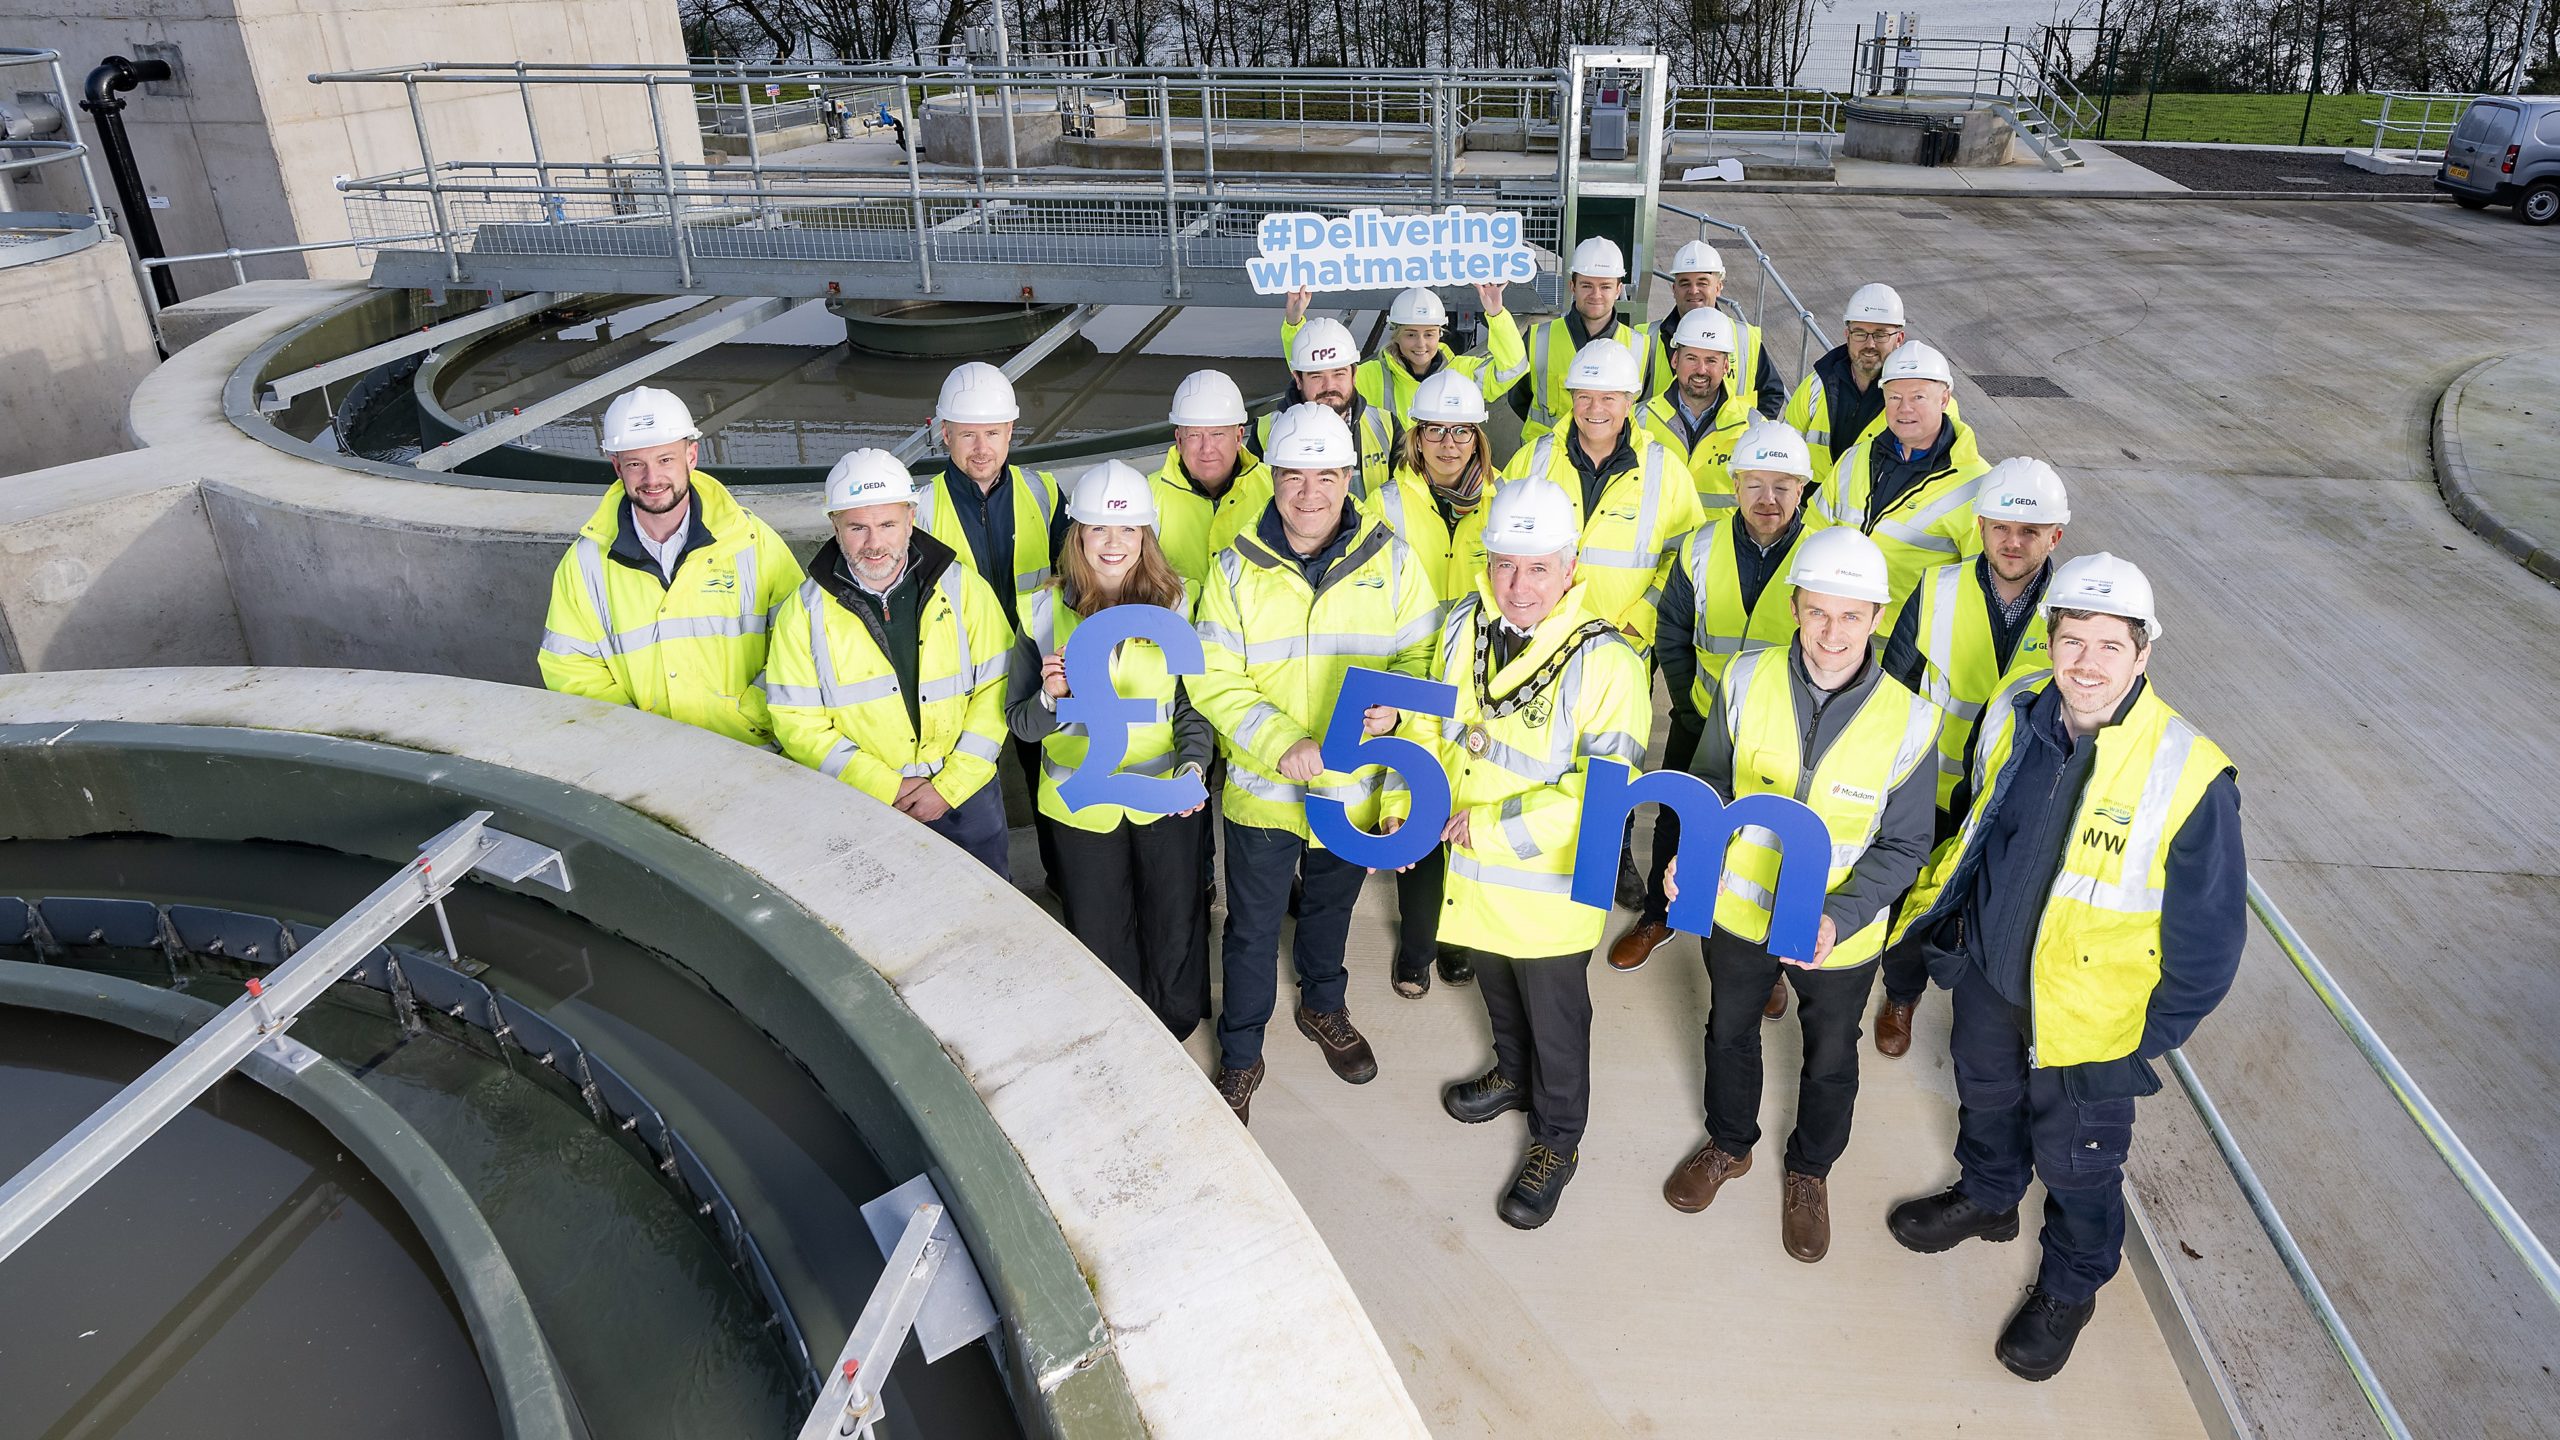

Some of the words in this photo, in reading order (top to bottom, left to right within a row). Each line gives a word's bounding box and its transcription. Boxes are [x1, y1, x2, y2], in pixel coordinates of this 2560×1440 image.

[1263, 212, 1517, 252] #Delivering
[1252, 249, 1531, 288] whatmatters
[1701, 331, 1716, 339] rps
[1311, 347, 1336, 361] rps
[1768, 450, 1789, 459] GEDA
[863, 481, 886, 490] GEDA
[1107, 500, 1127, 509] rps
[2015, 497, 2037, 506] GEDA
[2038, 642, 2048, 650] GE
[1056, 604, 1209, 814] £
[1305, 666, 1459, 870] 5
[1571, 756, 1832, 963] m
[1841, 786, 1875, 801] McAdam
[2082, 827, 2126, 855] WW
